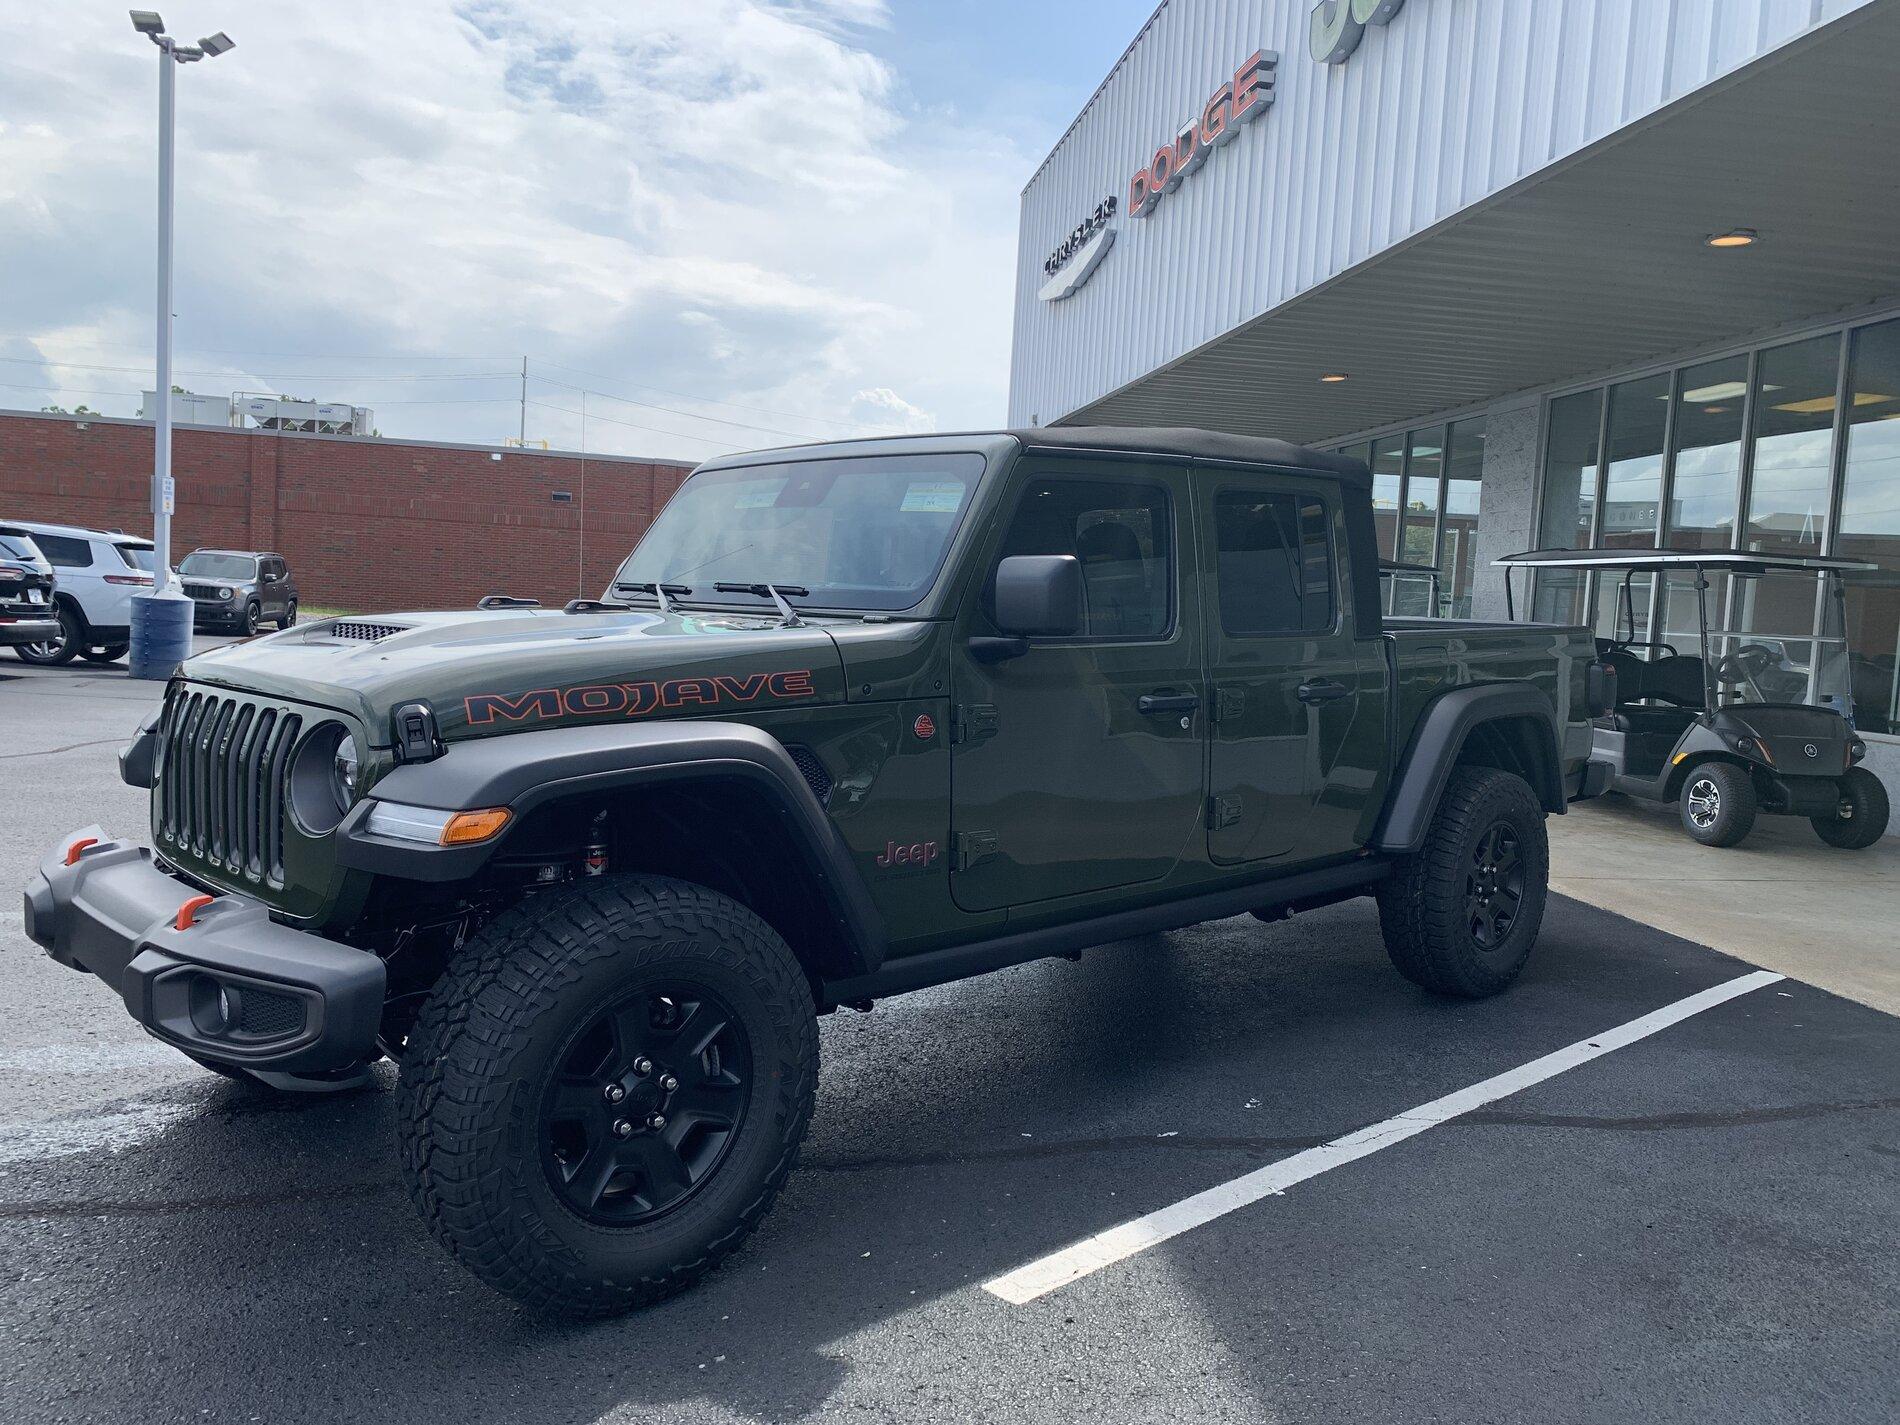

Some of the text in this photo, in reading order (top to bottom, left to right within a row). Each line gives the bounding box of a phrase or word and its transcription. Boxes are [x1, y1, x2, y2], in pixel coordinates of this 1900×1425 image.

[1129, 49, 1278, 218] DODGE
[1044, 196, 1117, 276] CHRYSLER
[464, 670, 814, 724] MOJAVE
[877, 841, 939, 868] Jeep
